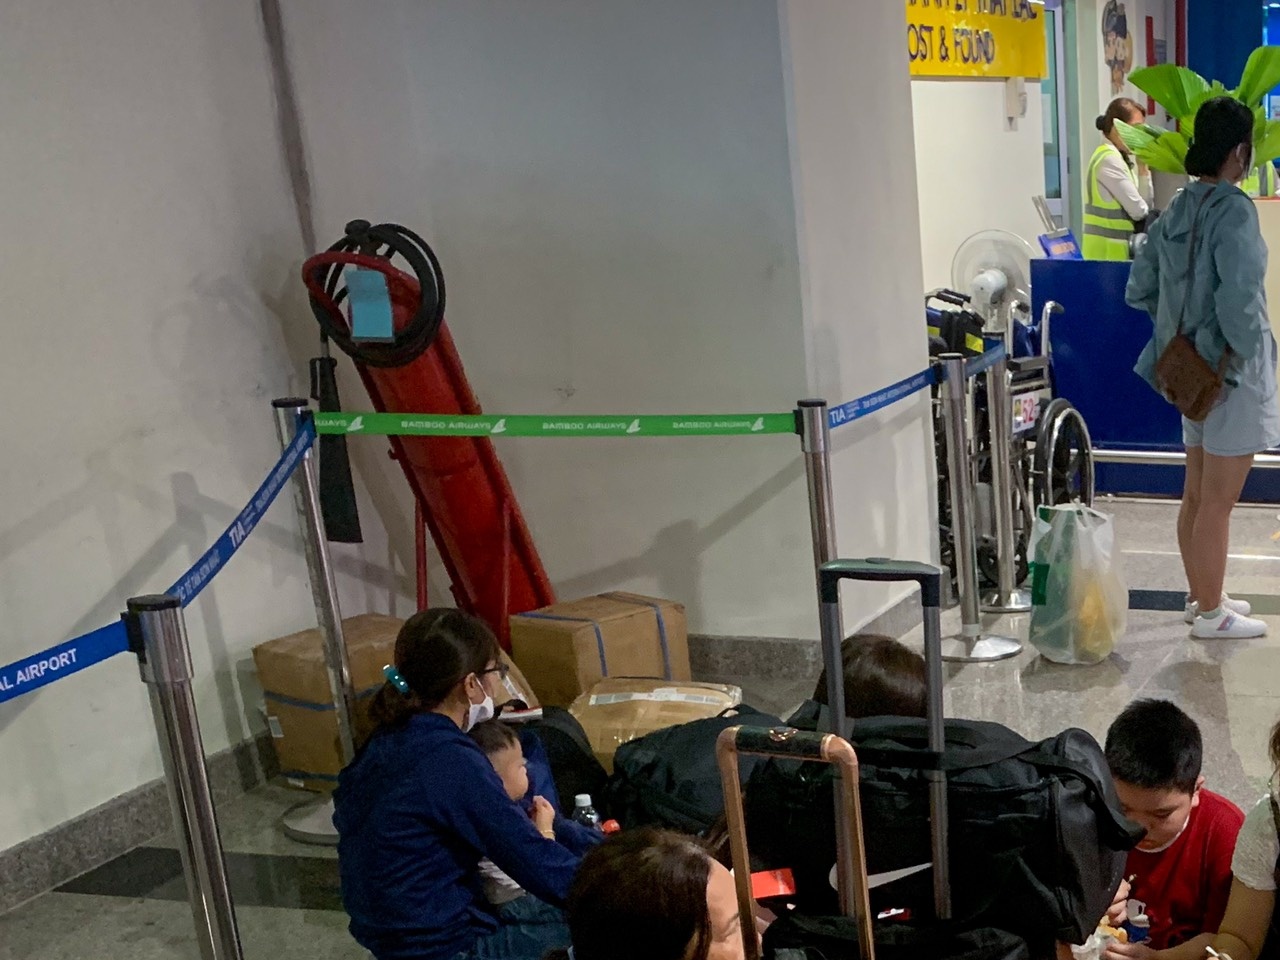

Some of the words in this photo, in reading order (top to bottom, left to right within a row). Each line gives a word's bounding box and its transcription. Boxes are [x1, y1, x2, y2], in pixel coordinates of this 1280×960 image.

[939, 26, 950, 61] &
[953, 28, 995, 63] FOUND
[401, 420, 446, 429] BAMBOO
[449, 421, 491, 430] AIRWAYS
[542, 421, 584, 430] BAMBOO
[586, 421, 627, 430] AIRWAYS
[829, 408, 846, 424] TIA
[228, 520, 247, 548] TIA
[16, 648, 77, 685] AIRPORT
